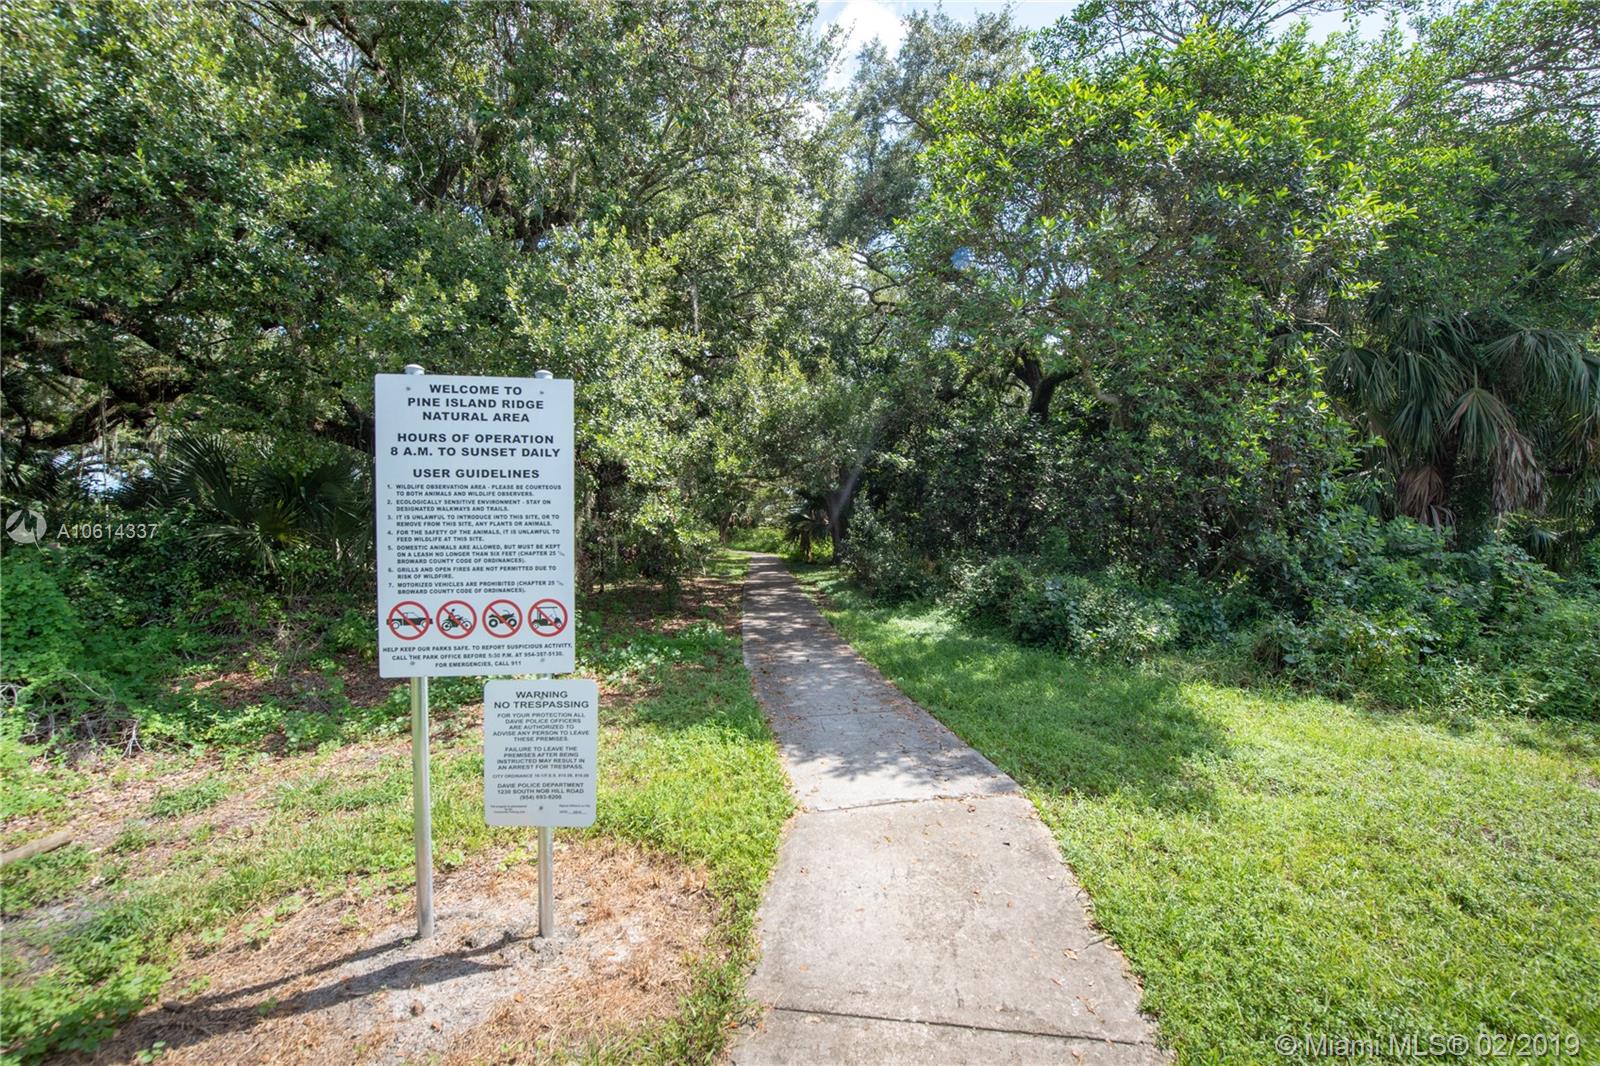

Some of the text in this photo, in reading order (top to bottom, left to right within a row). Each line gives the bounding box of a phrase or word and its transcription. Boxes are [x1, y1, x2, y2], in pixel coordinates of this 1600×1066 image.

[429, 384, 522, 396] WELCOME TO
[407, 397, 544, 410] PINE ISLAND RIDGE
[422, 412, 530, 423] NATURAL AREA
[397, 433, 554, 444] HOURS OF OPERATION
[390, 447, 560, 458] 8 A.M. TO SUNSET DAILY
[413, 468, 540, 479] USER GUIDELINES
[515, 690, 568, 699] WARNING
[493, 701, 589, 709] NO TRESPASSING
